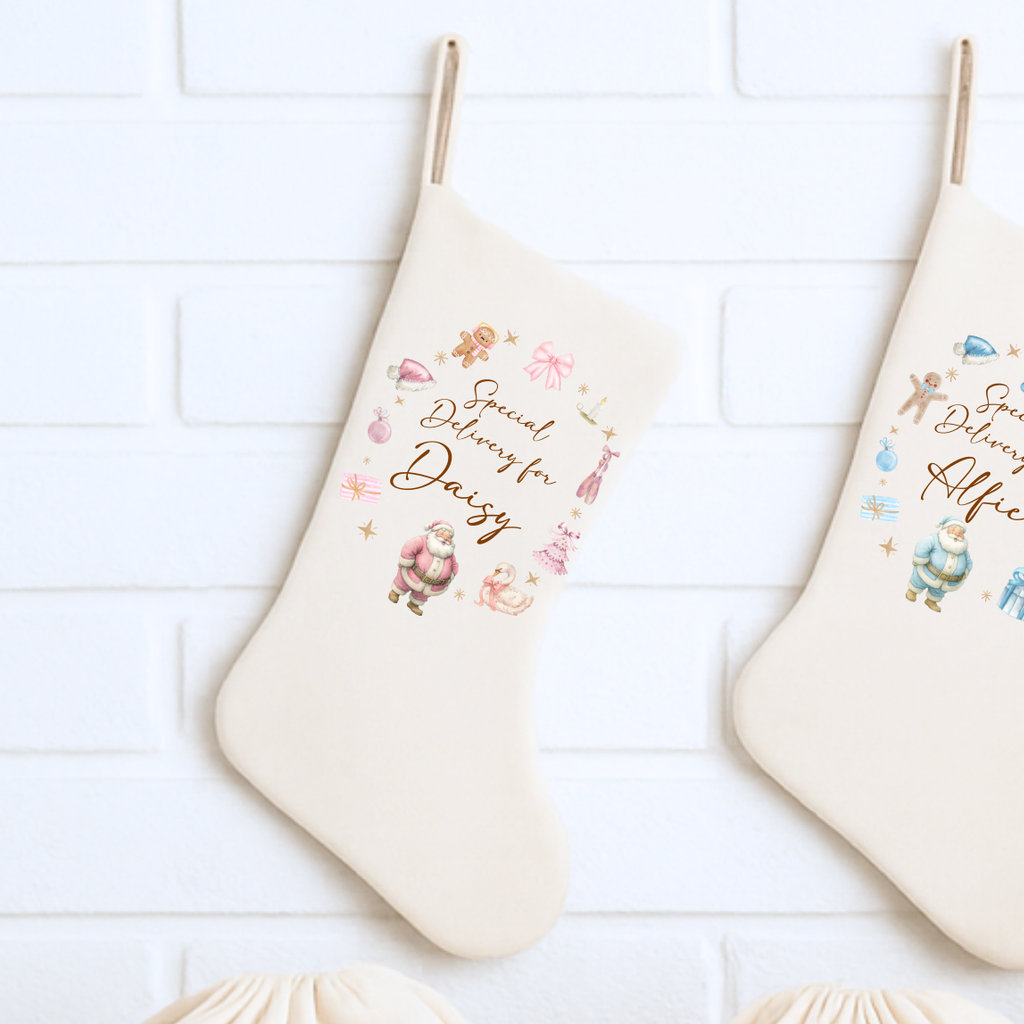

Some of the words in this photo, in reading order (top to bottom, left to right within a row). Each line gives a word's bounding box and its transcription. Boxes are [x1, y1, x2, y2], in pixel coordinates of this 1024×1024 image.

[420, 399, 523, 473] Delivery
[517, 458, 556, 485] for
[464, 379, 554, 441] Special
[390, 441, 521, 544] Daisy
